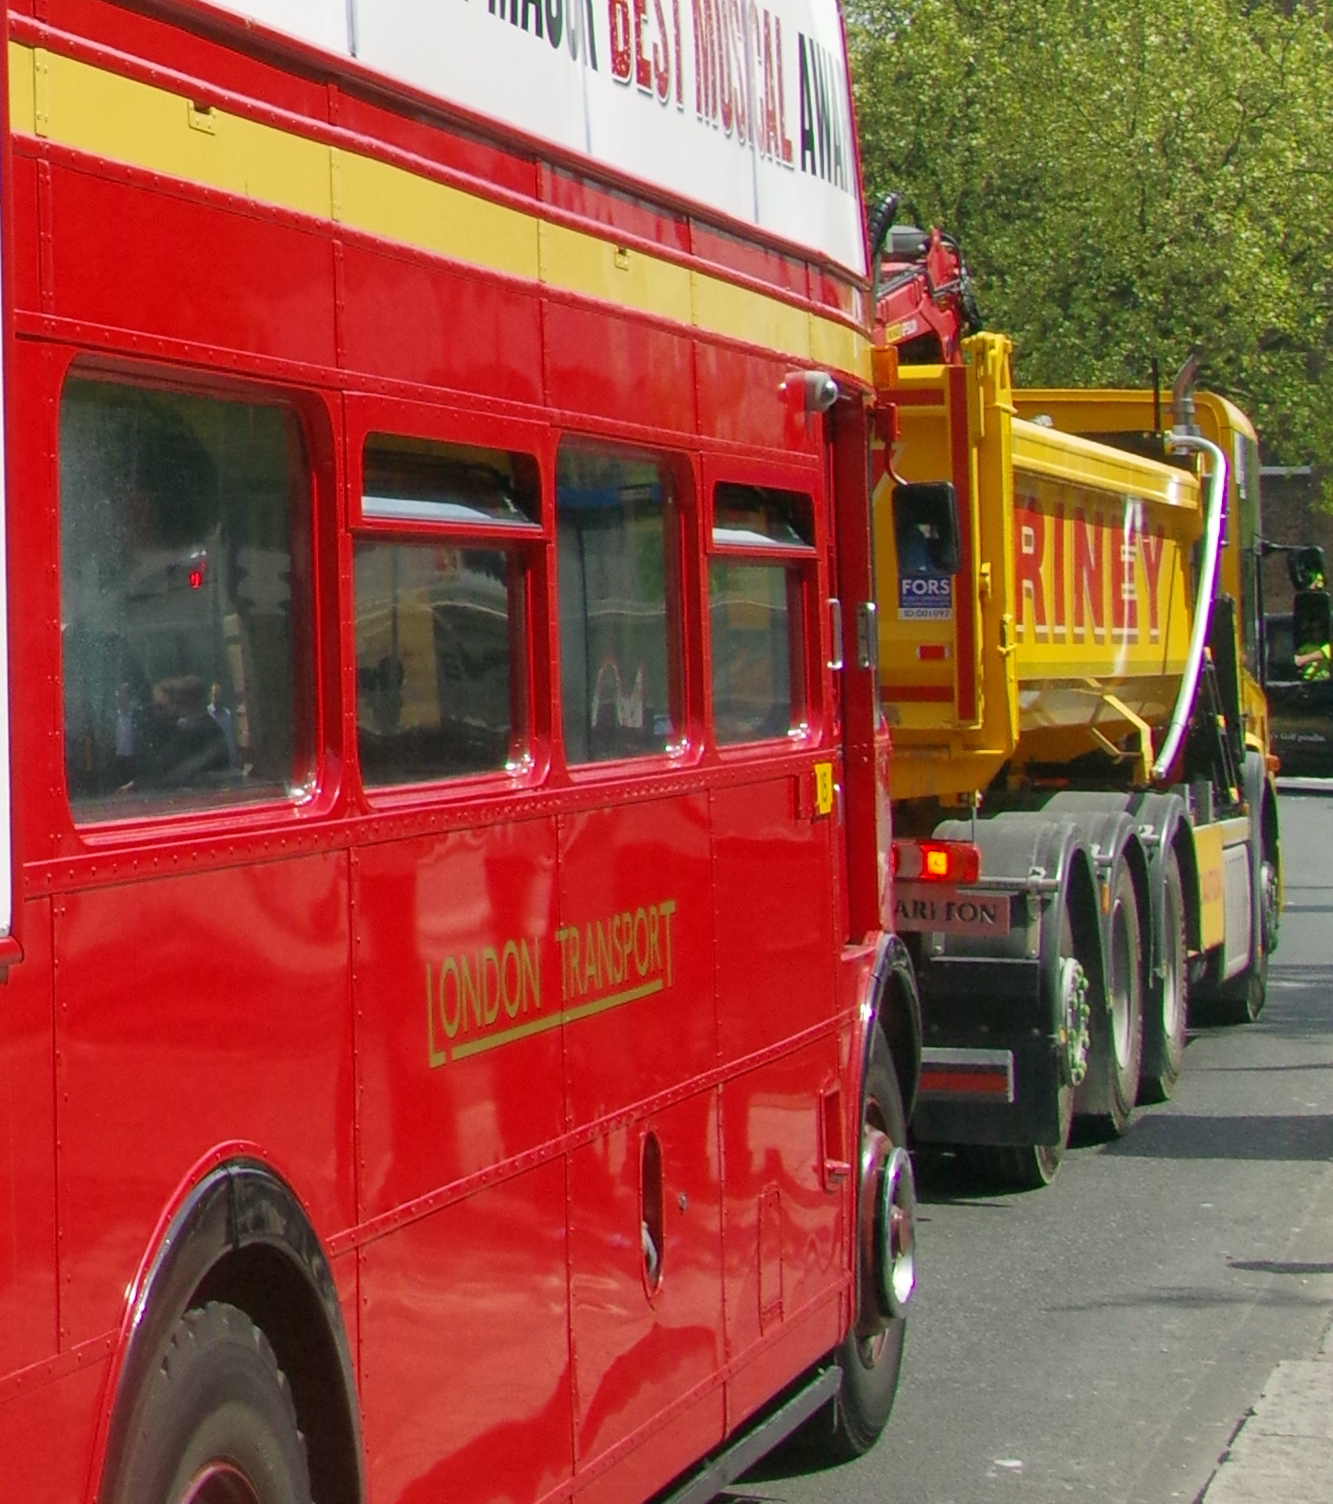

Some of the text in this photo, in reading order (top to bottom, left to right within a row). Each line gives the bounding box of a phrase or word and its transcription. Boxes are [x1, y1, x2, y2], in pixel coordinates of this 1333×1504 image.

[901, 579, 950, 595] FORS
[426, 899, 676, 1069] LONDON TRANSPORT
